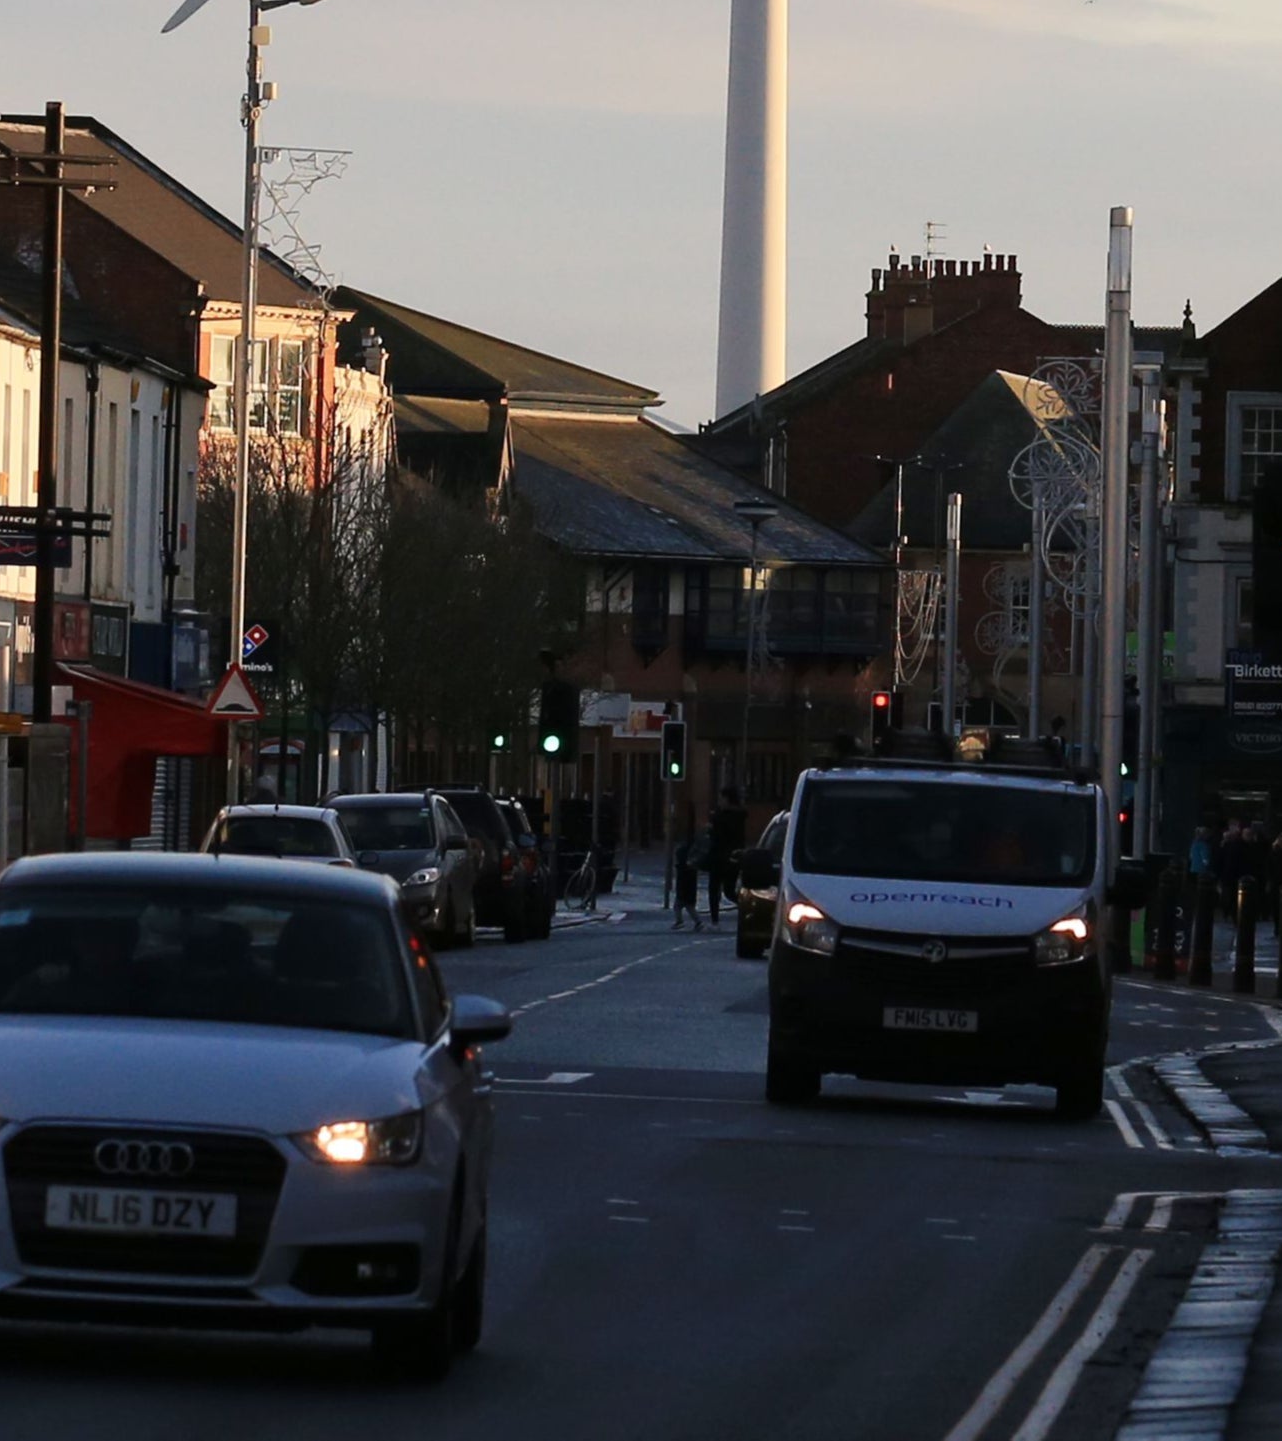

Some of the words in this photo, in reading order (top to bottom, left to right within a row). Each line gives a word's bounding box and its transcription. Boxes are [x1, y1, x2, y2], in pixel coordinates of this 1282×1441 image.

[226, 661, 274, 672] mino's
[850, 892, 1014, 909] openreach
[69, 1191, 141, 1225] NL16
[151, 1196, 215, 1229] DZY
